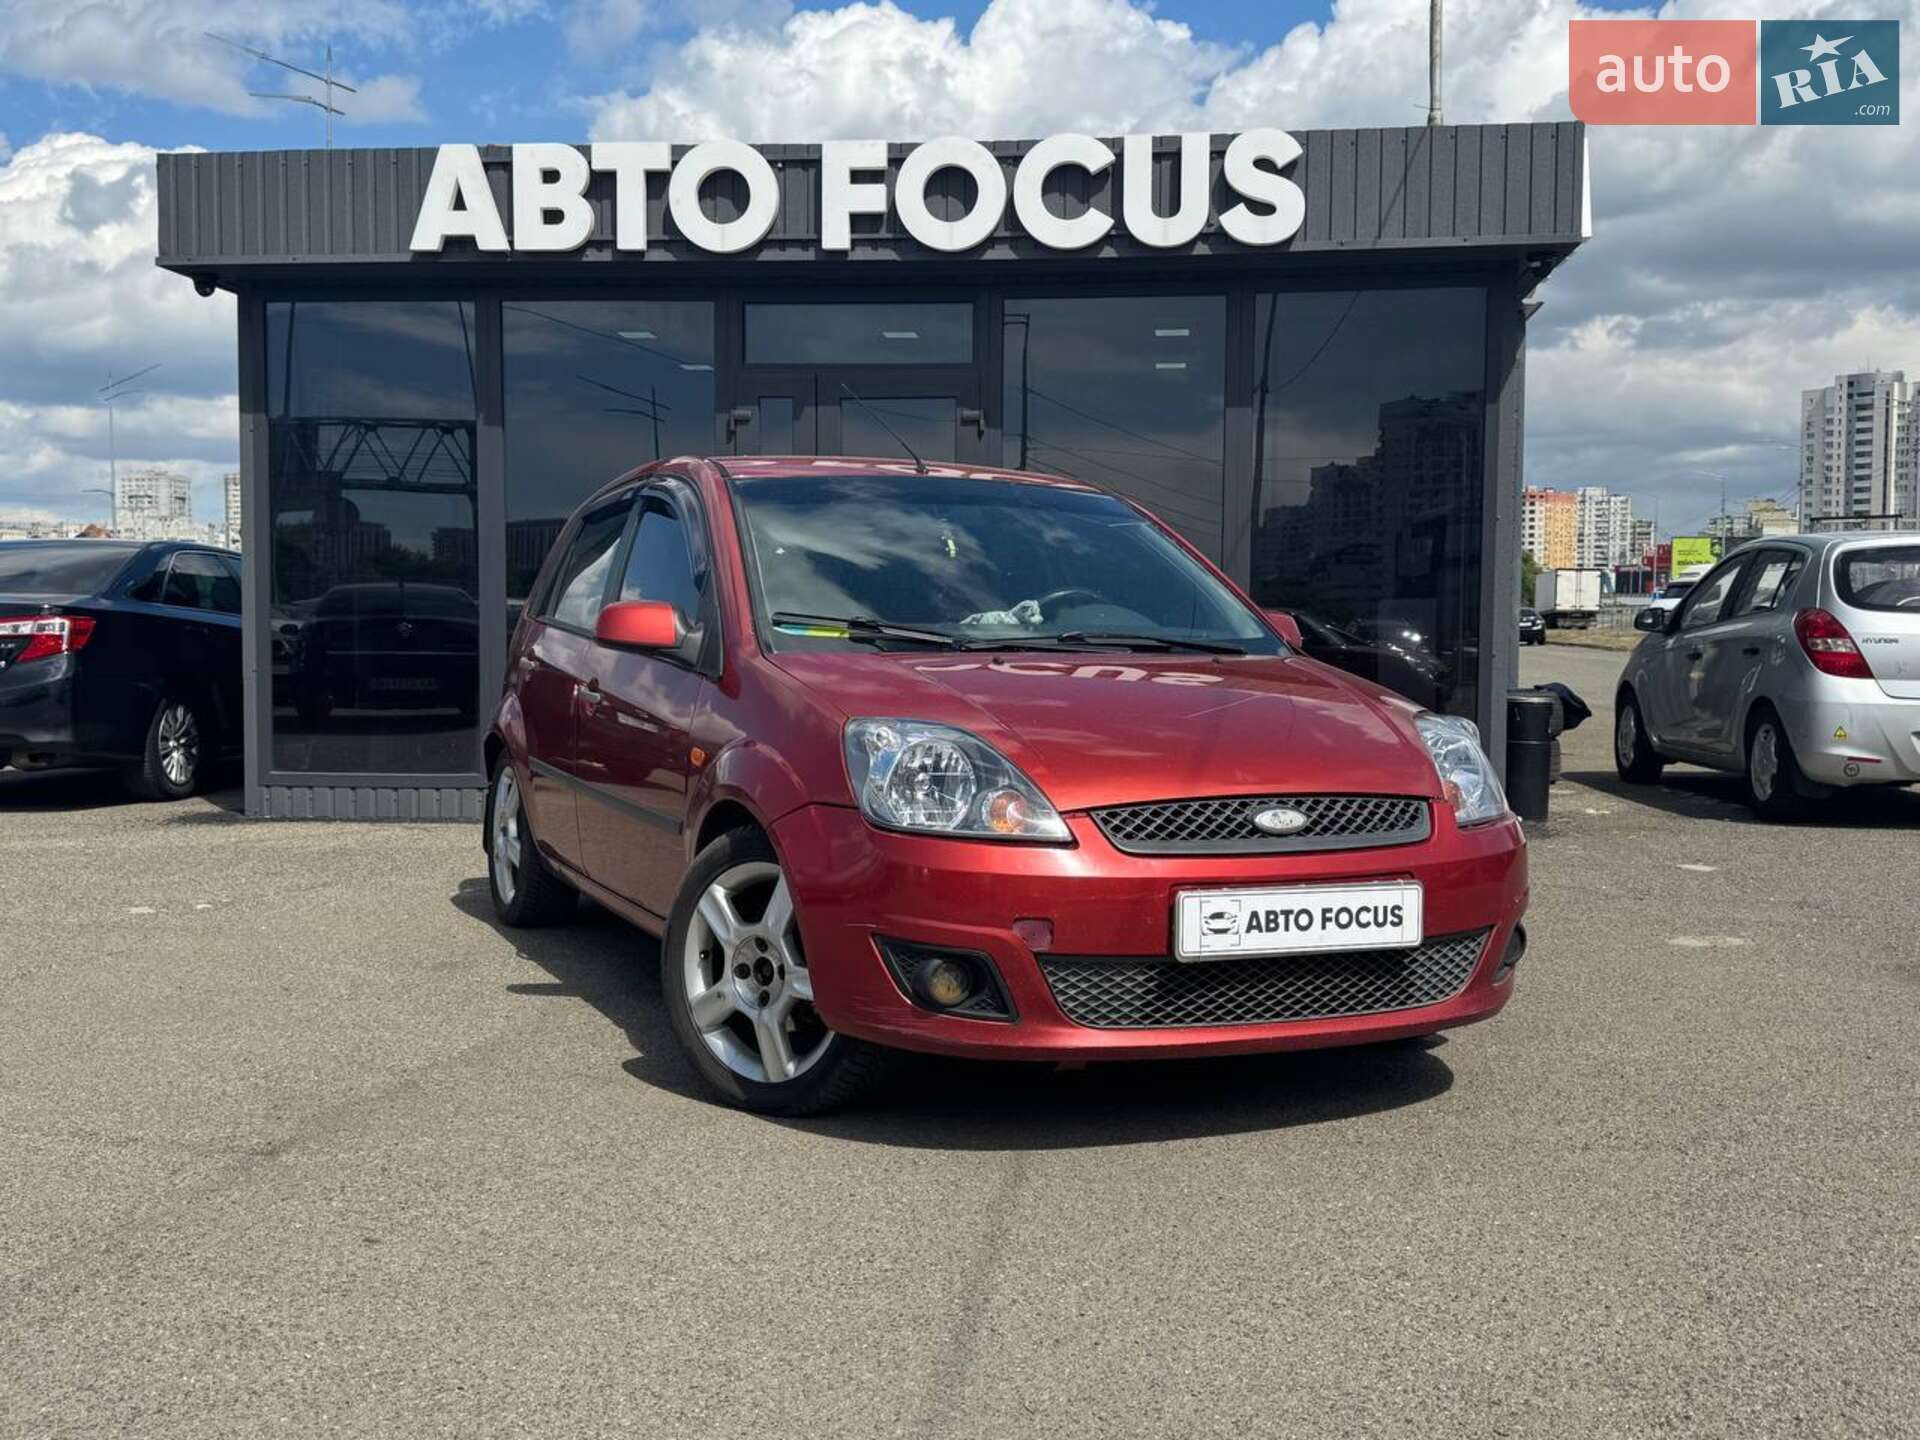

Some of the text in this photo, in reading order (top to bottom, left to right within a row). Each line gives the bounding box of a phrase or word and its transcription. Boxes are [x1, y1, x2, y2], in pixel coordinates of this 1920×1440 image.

[409, 128, 1306, 253] АВТО FOCUS
[1245, 904, 1404, 934] АВТО FOCUS
